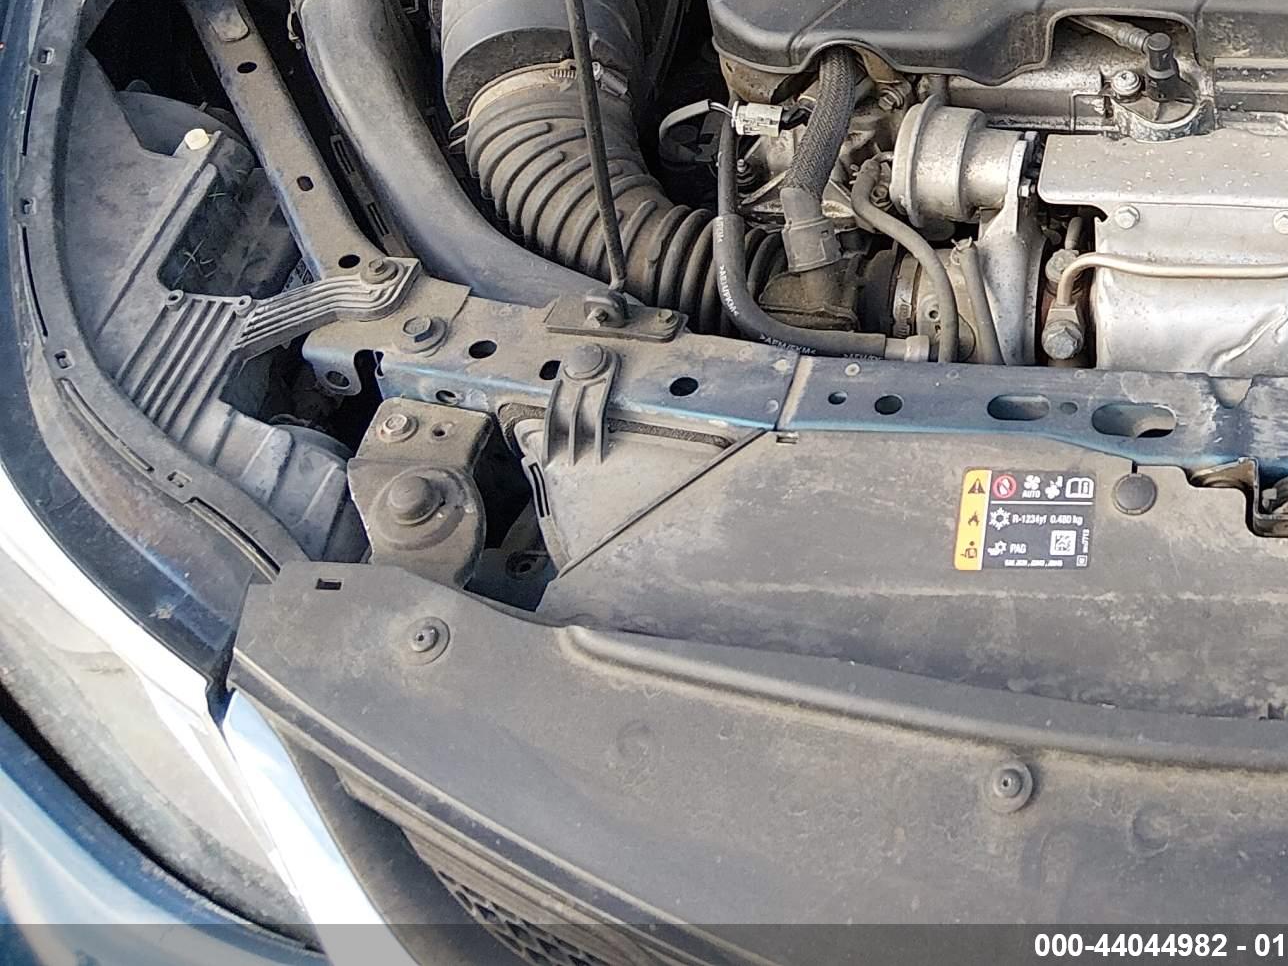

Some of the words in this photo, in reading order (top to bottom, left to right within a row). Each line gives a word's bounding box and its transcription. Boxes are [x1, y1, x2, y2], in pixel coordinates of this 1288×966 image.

[1022, 490, 1041, 498] AUTO
[1073, 515, 1083, 526] kg
[1009, 543, 1027, 554] PAG
